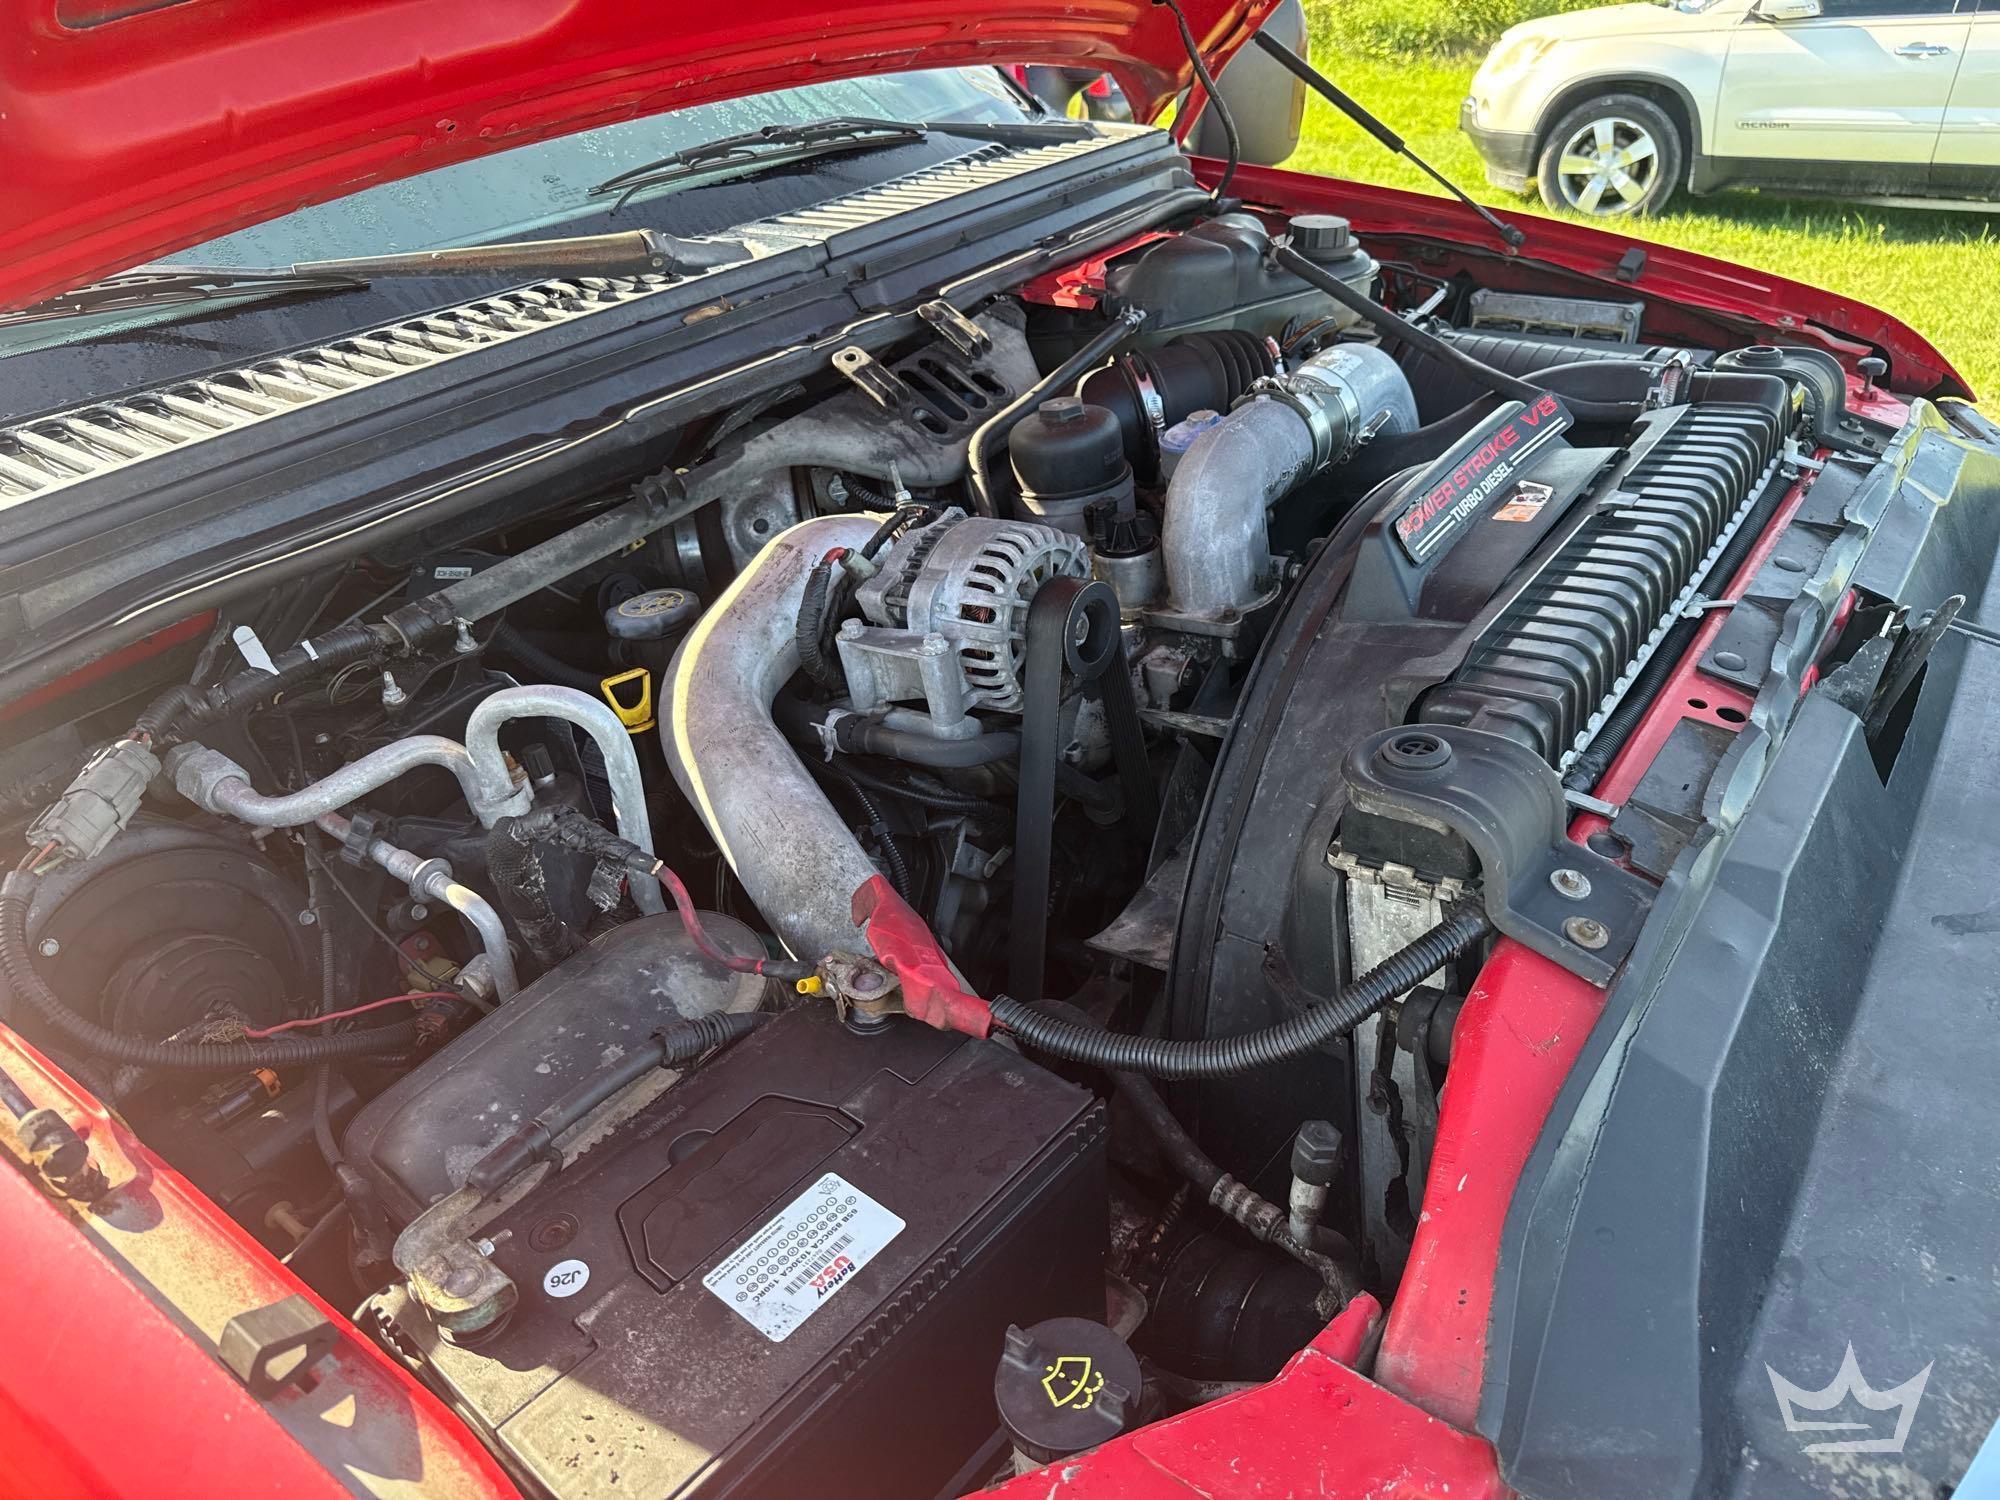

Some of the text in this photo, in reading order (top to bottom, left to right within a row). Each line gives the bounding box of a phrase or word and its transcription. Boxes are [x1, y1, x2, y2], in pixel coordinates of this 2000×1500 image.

[1452, 425, 1520, 492] STROKE
[1519, 394, 1558, 427] V8
[1450, 461, 1514, 522] TURBO DIESEL
[551, 1270, 581, 1288] J26
[751, 1208, 857, 1302] 65B 850CCA 1030CA 150RC
[809, 1255, 851, 1288] USA
[816, 1261, 857, 1299] Battery
